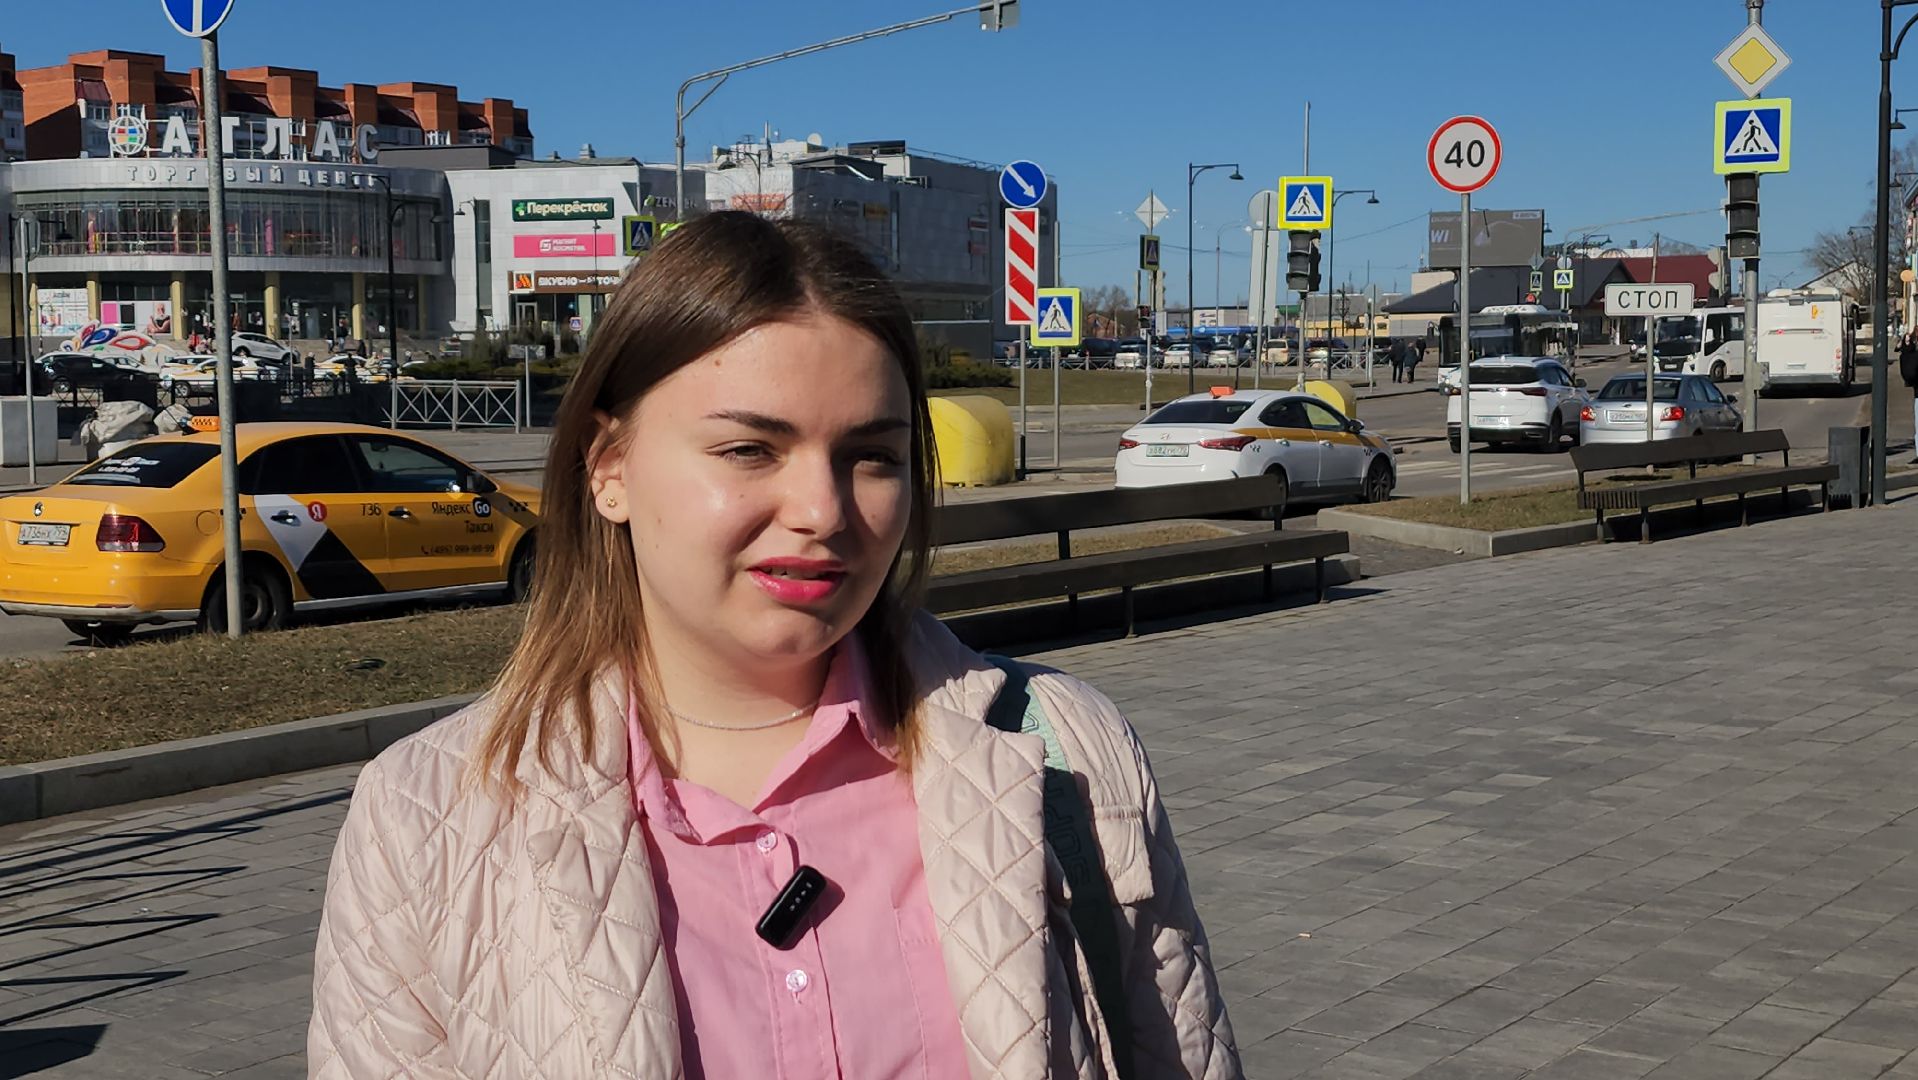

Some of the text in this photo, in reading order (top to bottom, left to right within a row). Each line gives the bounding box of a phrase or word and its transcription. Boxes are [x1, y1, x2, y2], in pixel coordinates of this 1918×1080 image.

[162, 115, 378, 160] АТЛАС
[1444, 139, 1485, 168] 40
[127, 164, 283, 184] ТОРГВЫЙ
[527, 201, 608, 216] Перекрёсток
[655, 196, 698, 209] ZENEN
[1618, 290, 1678, 309] СТОП
[431, 500, 490, 516] Яндекс Go
[464, 520, 494, 533] Такси
